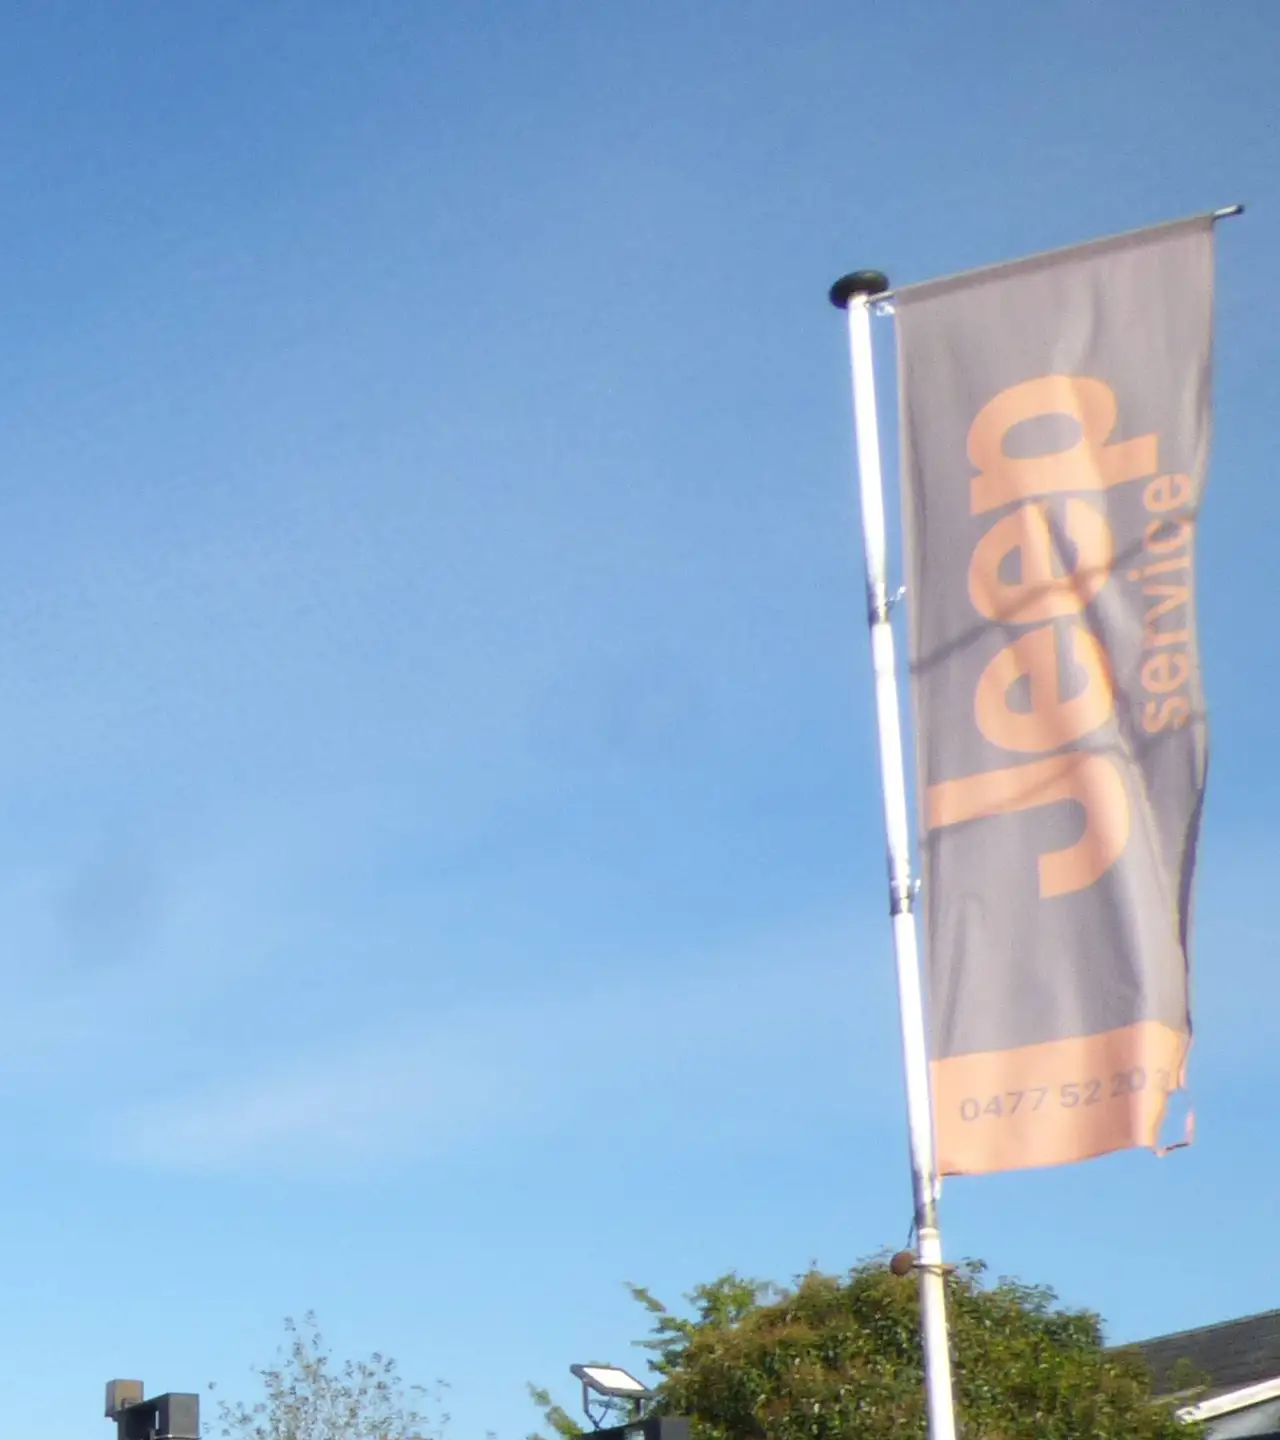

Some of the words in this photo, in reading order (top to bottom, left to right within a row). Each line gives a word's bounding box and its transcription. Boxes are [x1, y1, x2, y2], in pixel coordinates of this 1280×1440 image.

[927, 372, 1159, 899] Jeep
[1142, 471, 1192, 736] service
[959, 1086, 1049, 1122] 0477
[1058, 1077, 1102, 1109] 52
[1109, 1064, 1147, 1097] 20
